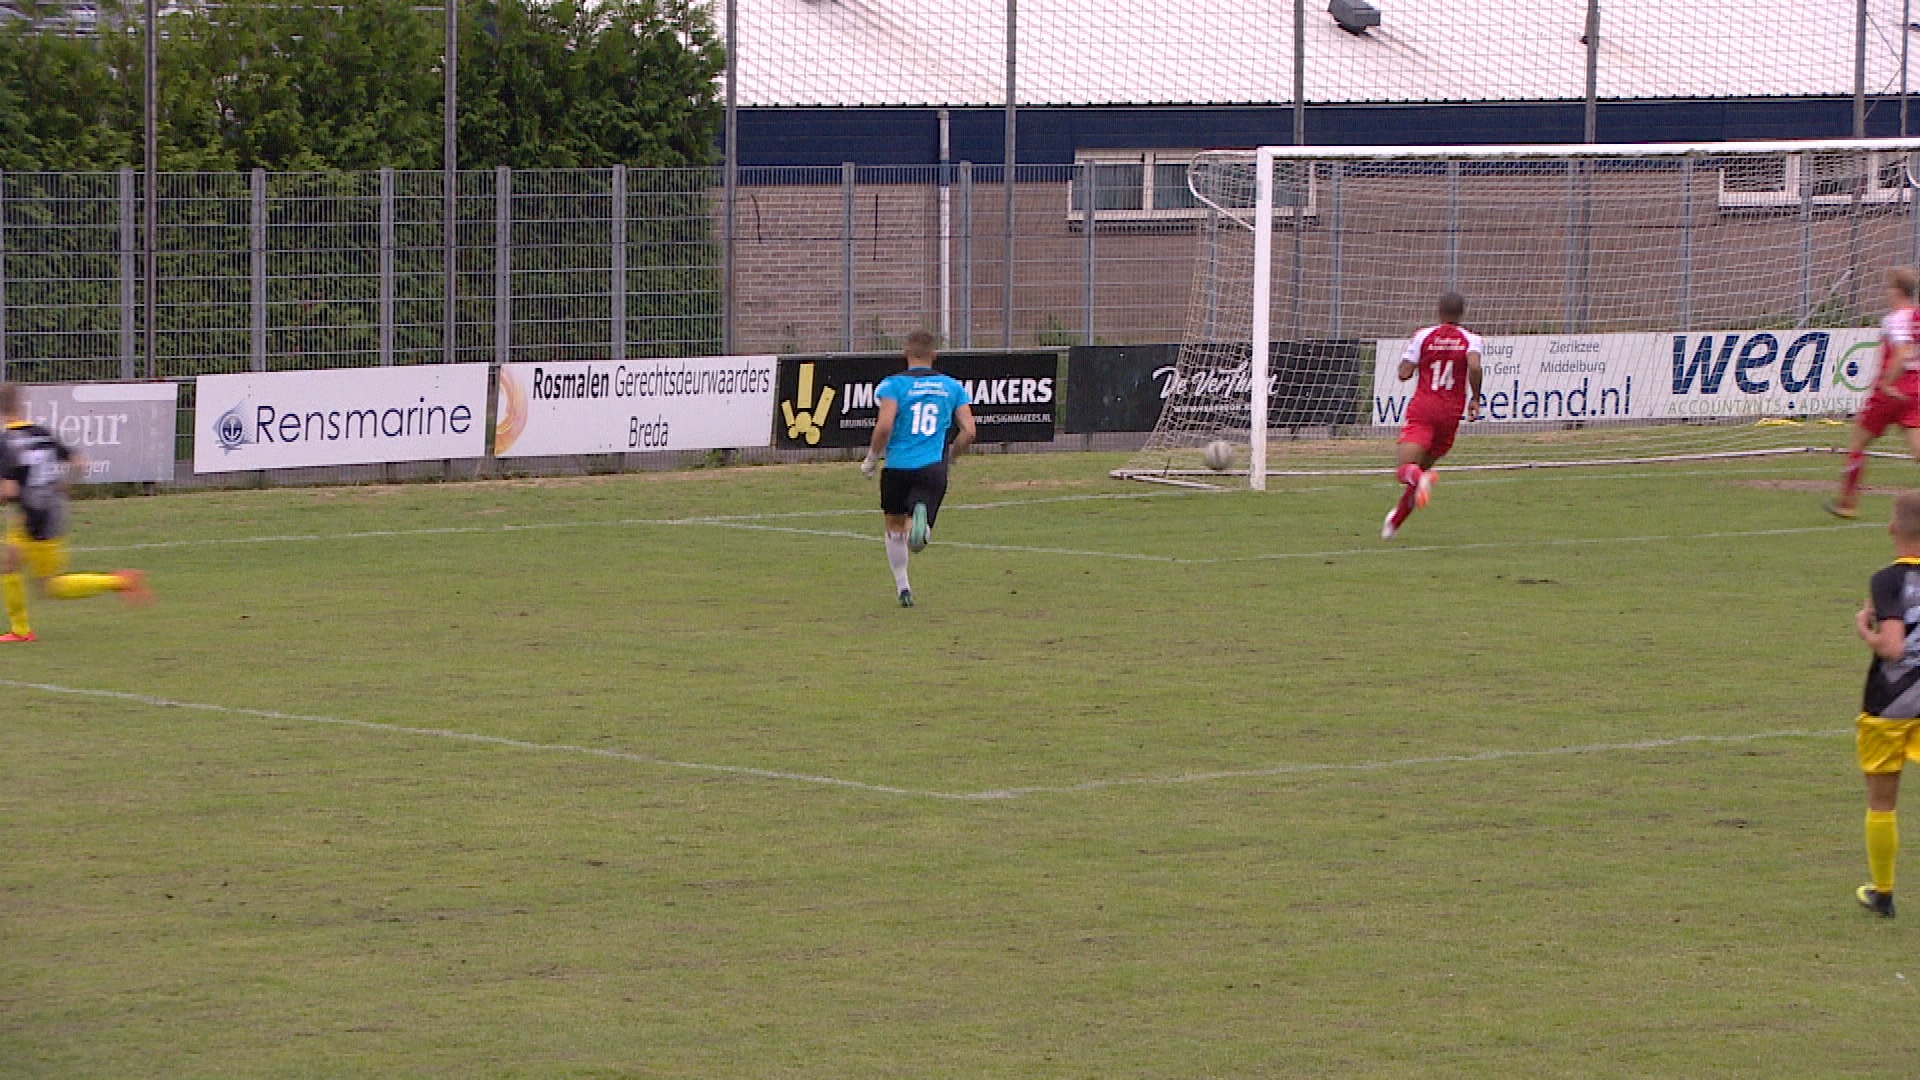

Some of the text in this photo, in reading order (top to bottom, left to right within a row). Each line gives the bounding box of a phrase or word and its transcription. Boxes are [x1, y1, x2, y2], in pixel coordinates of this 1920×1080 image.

[1549, 340, 1600, 354] Zierikzee
[1672, 331, 1830, 395] wea
[533, 361, 770, 400] Rosmalen Gerechtsdeurwaarders
[1429, 360, 1456, 391] 14
[1494, 362, 1520, 375] Gent
[1540, 360, 1606, 375] Middelburg
[256, 396, 472, 443] Rensmarine
[910, 401, 939, 436] 16
[1667, 398, 1782, 415] ACCOUNTANTS
[628, 414, 669, 448] Breda
